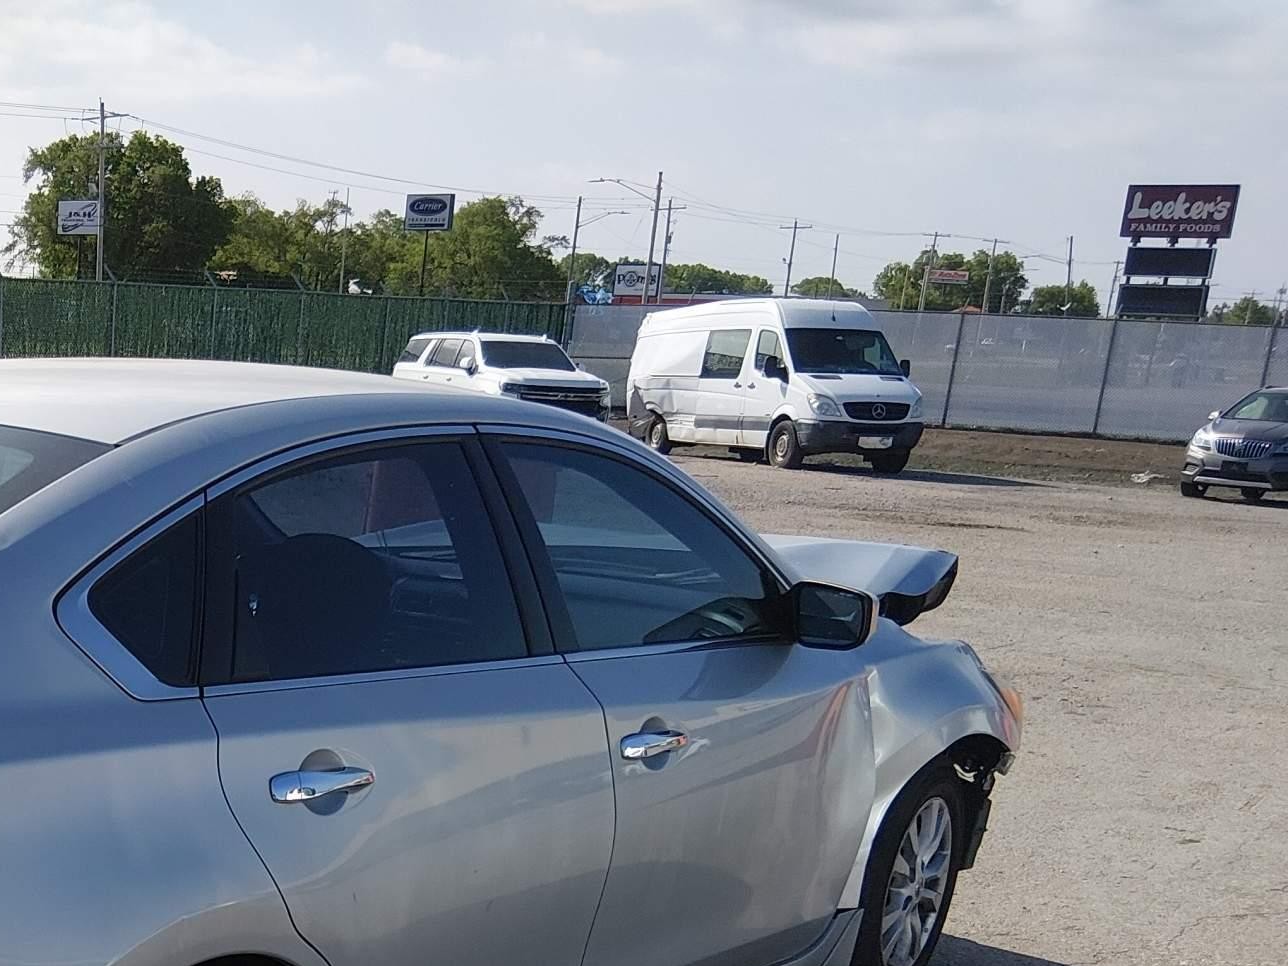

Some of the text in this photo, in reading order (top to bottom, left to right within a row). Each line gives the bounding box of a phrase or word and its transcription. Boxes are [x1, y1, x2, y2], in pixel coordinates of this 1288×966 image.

[414, 201, 443, 210] Carrier
[1127, 191, 1232, 221] Leeker's
[1129, 223, 1221, 232] FAMILY FOODS
